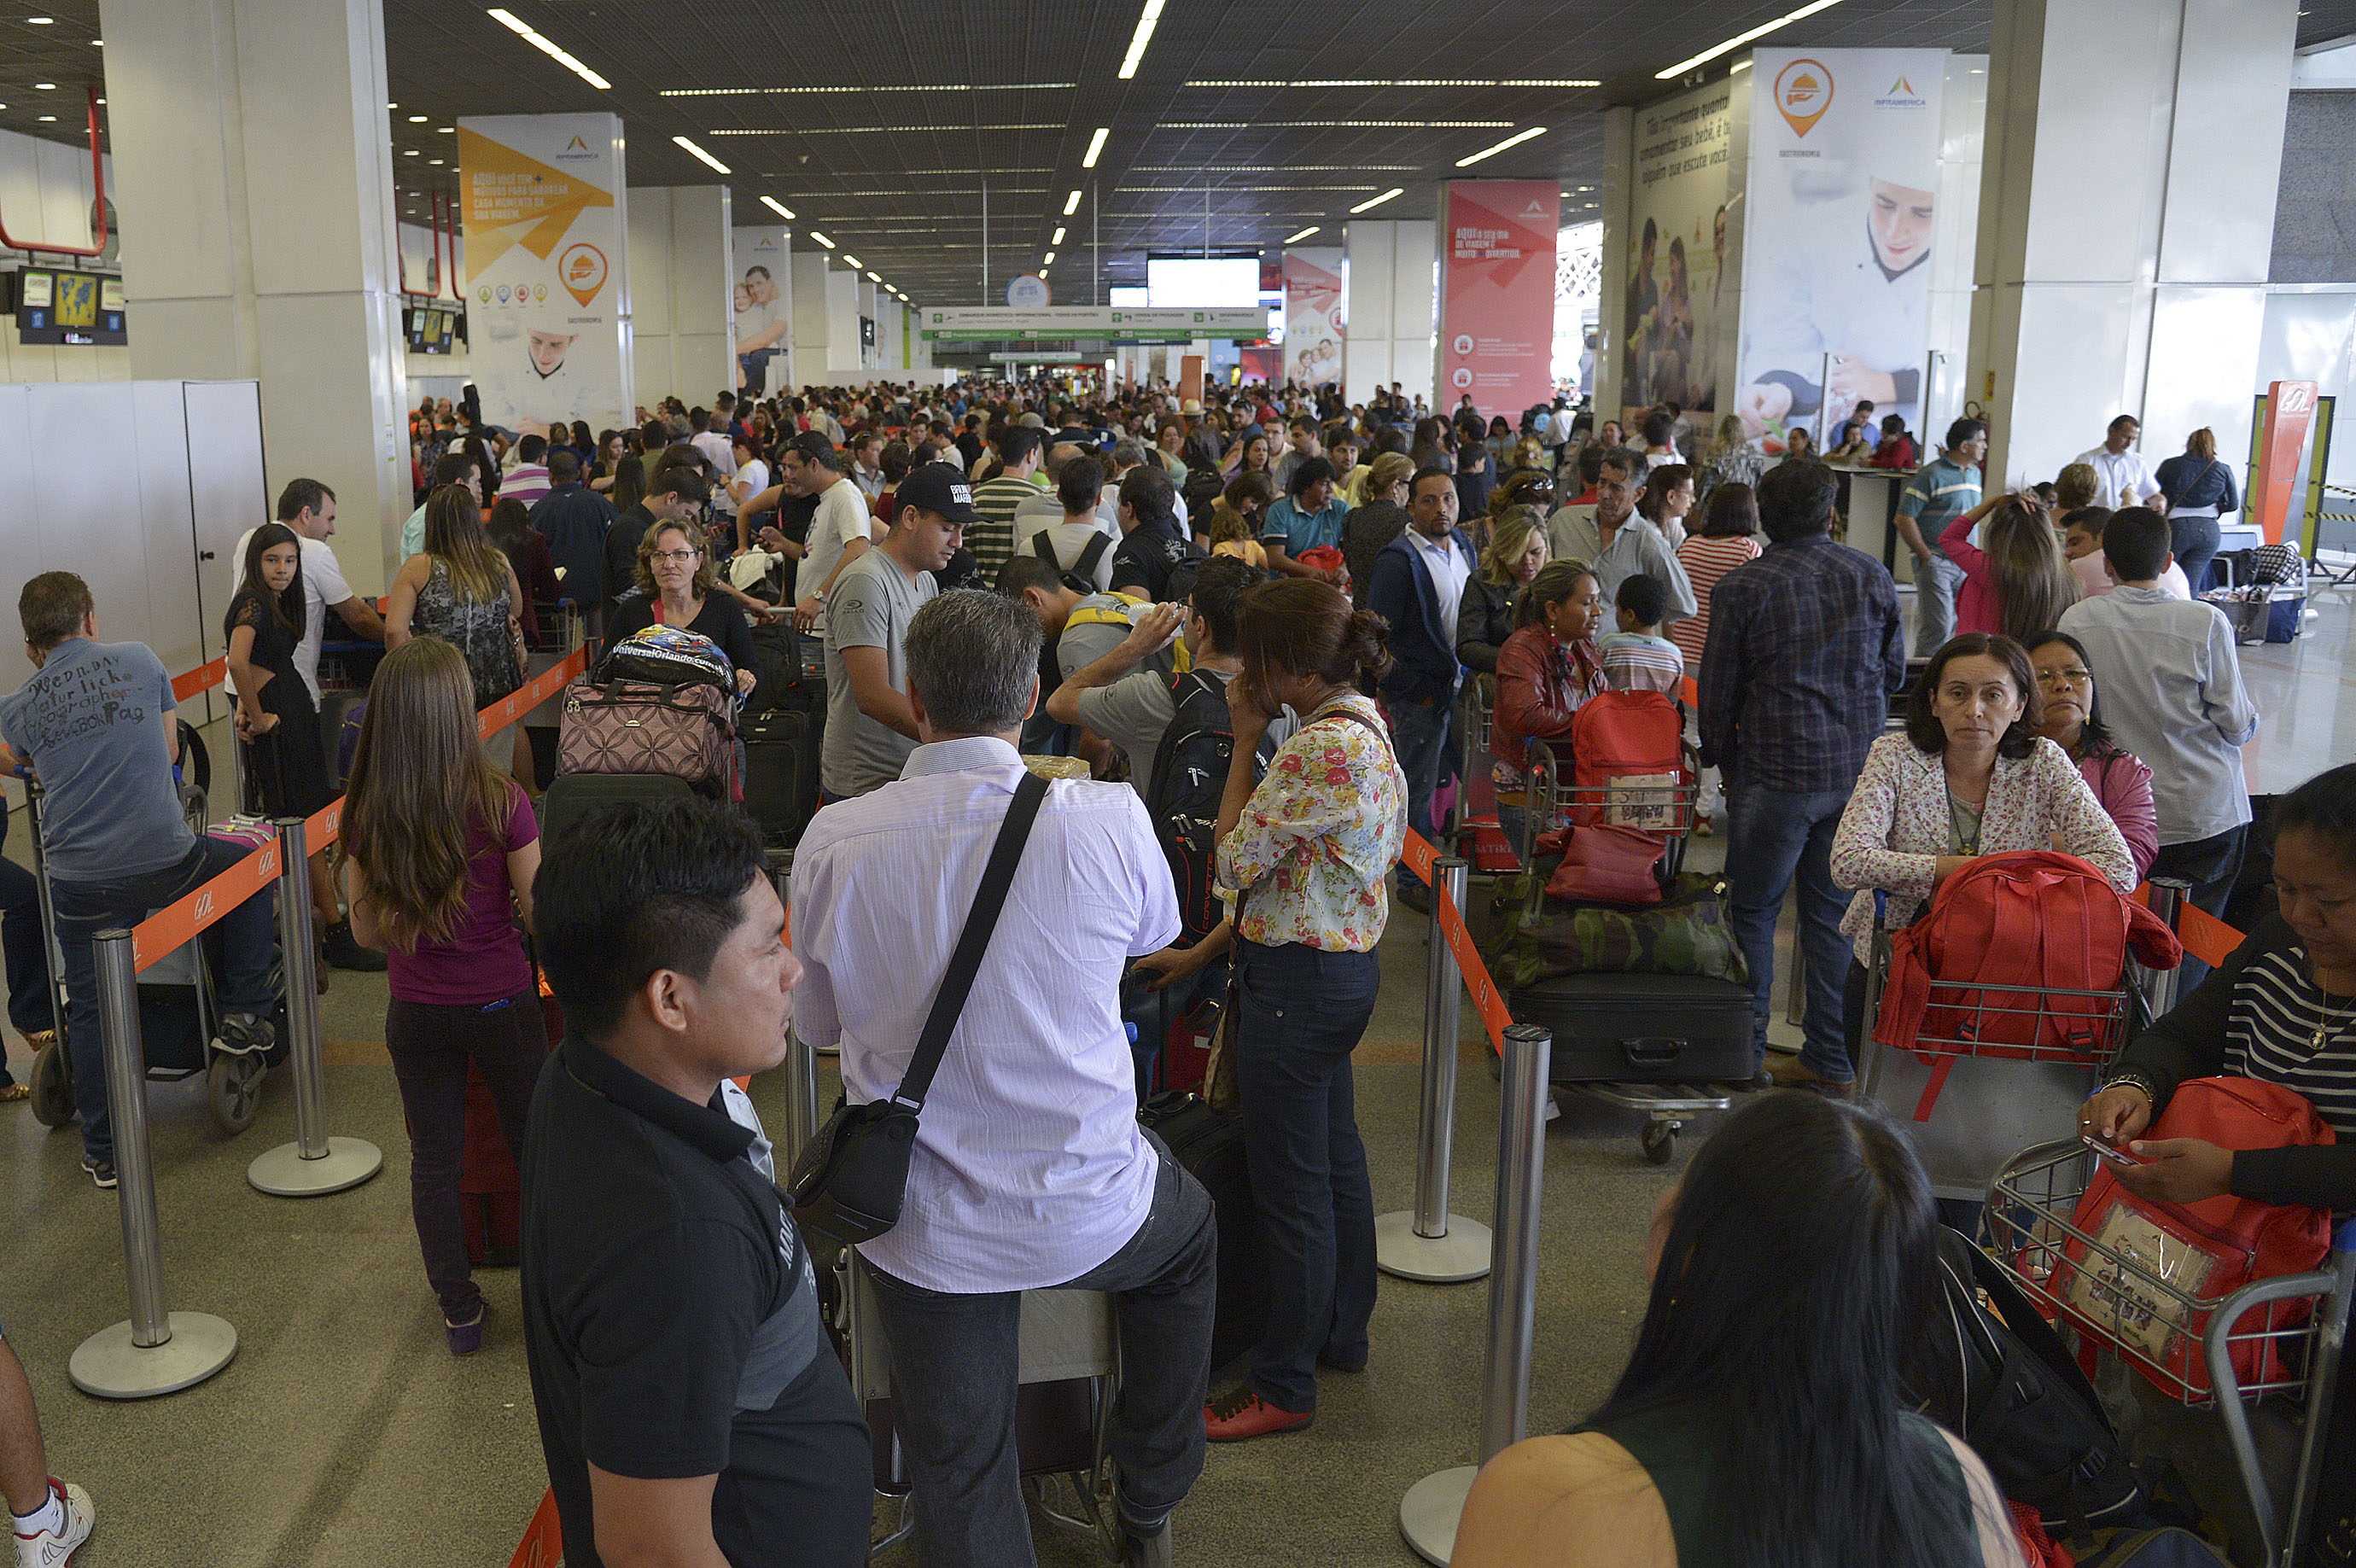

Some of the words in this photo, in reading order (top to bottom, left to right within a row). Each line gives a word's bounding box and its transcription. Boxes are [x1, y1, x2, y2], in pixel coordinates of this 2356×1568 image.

[1456, 227, 1477, 240] AQUI
[2279, 388, 2310, 412] GOL
[258, 848, 276, 876] GOL
[194, 890, 214, 920] GOL
[1202, 853, 1213, 930] CORVETTE
